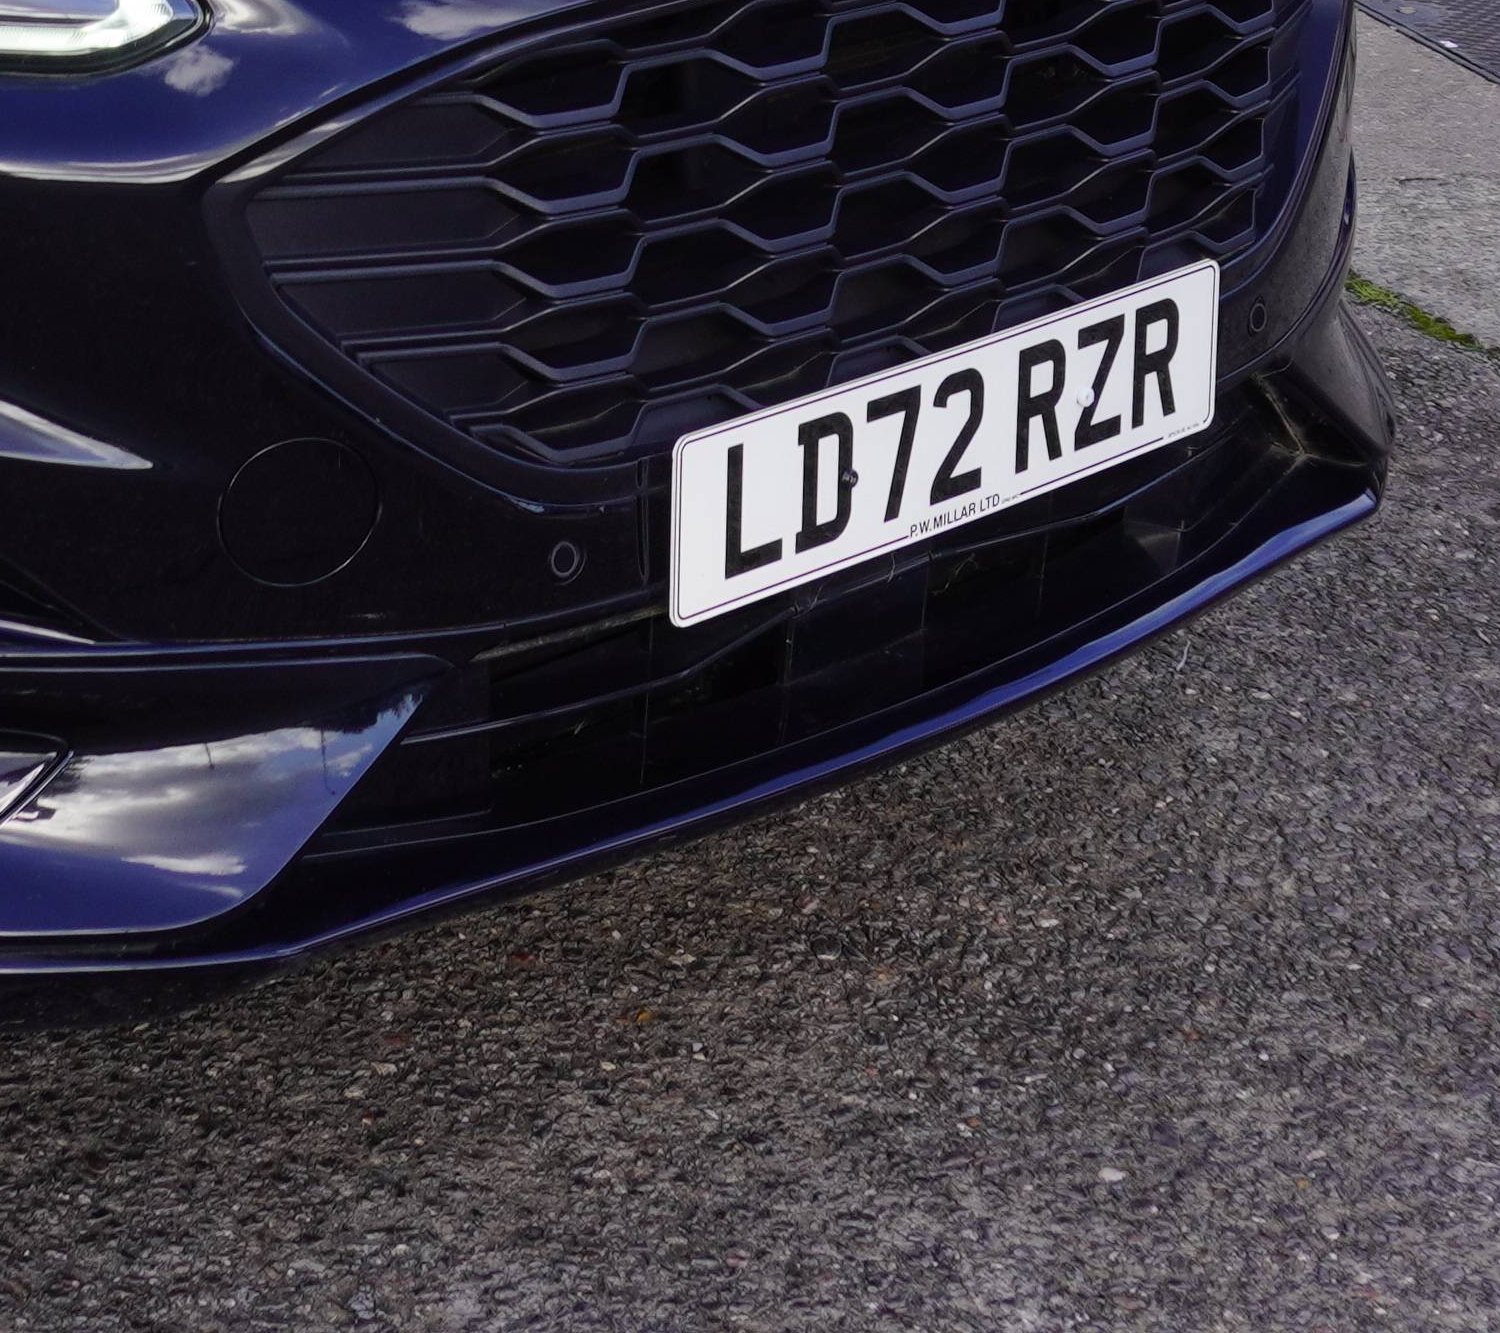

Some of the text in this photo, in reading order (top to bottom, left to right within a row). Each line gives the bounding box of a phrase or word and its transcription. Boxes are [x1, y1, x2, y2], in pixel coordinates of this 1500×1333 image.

[724, 297, 1179, 580] LD72 RZR
[980, 493, 1000, 512] LTD
